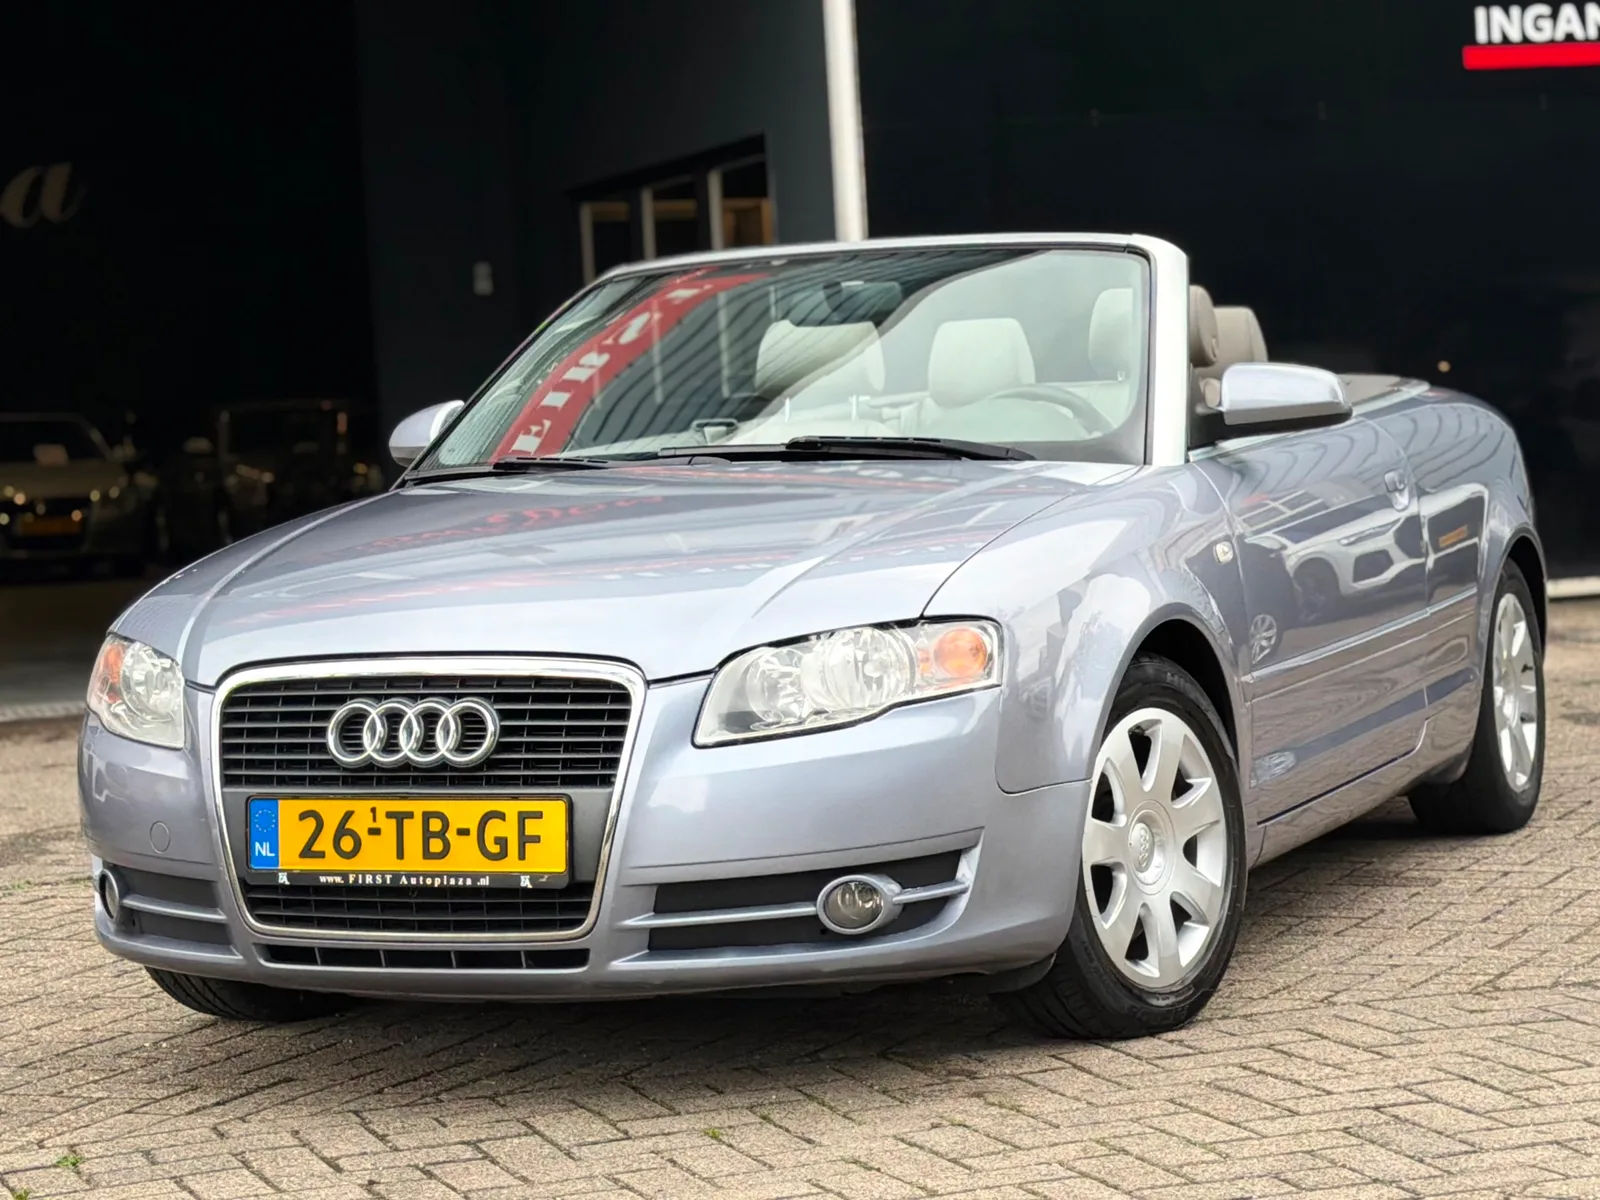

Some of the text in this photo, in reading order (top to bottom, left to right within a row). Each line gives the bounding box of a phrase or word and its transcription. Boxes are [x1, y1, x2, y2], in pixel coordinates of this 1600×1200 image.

[298, 809, 543, 861] 26-TB-GF
[255, 841, 276, 857] NL
[319, 874, 490, 887] www. FIRST Autoplaza .nl
